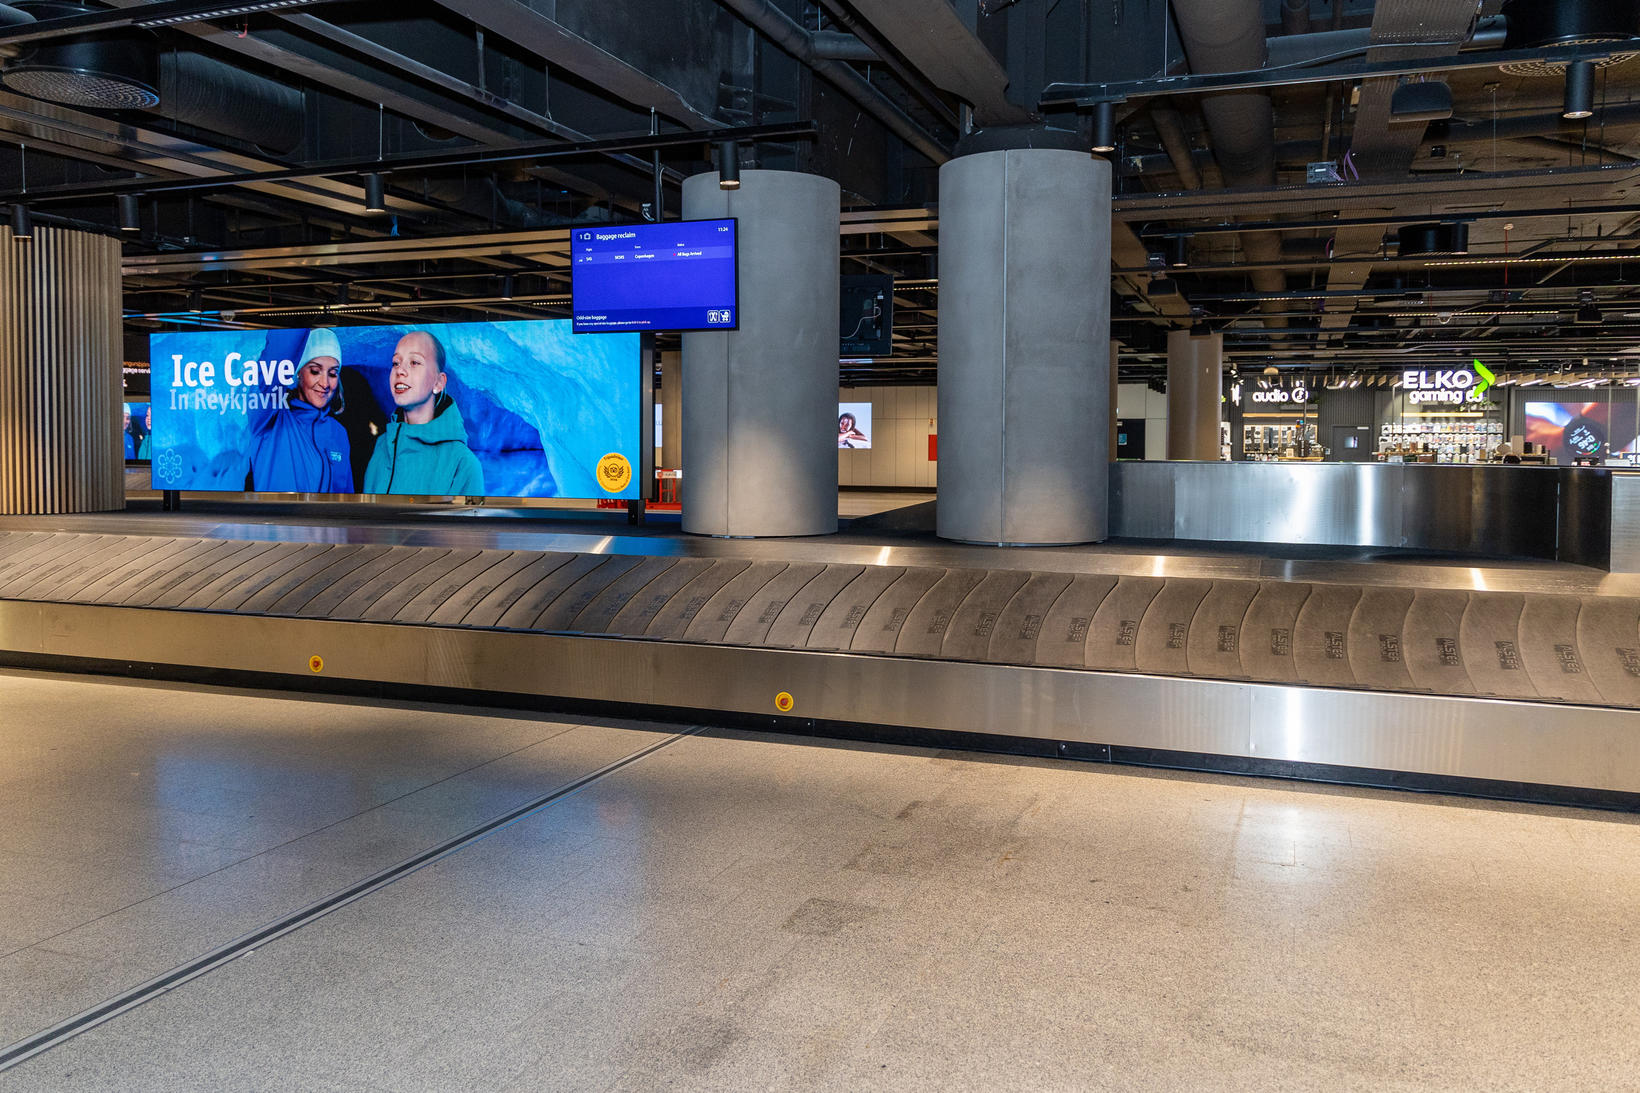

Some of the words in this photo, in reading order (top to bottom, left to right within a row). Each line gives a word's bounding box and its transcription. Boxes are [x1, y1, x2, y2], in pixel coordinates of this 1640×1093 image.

[171, 354, 215, 388] Ice
[224, 352, 295, 388] Cave
[1403, 370, 1472, 388] ELKO
[170, 388, 188, 410] In
[194, 386, 290, 415] Reykjavík
[1252, 388, 1288, 402] audio
[1409, 388, 1463, 404] gaming
